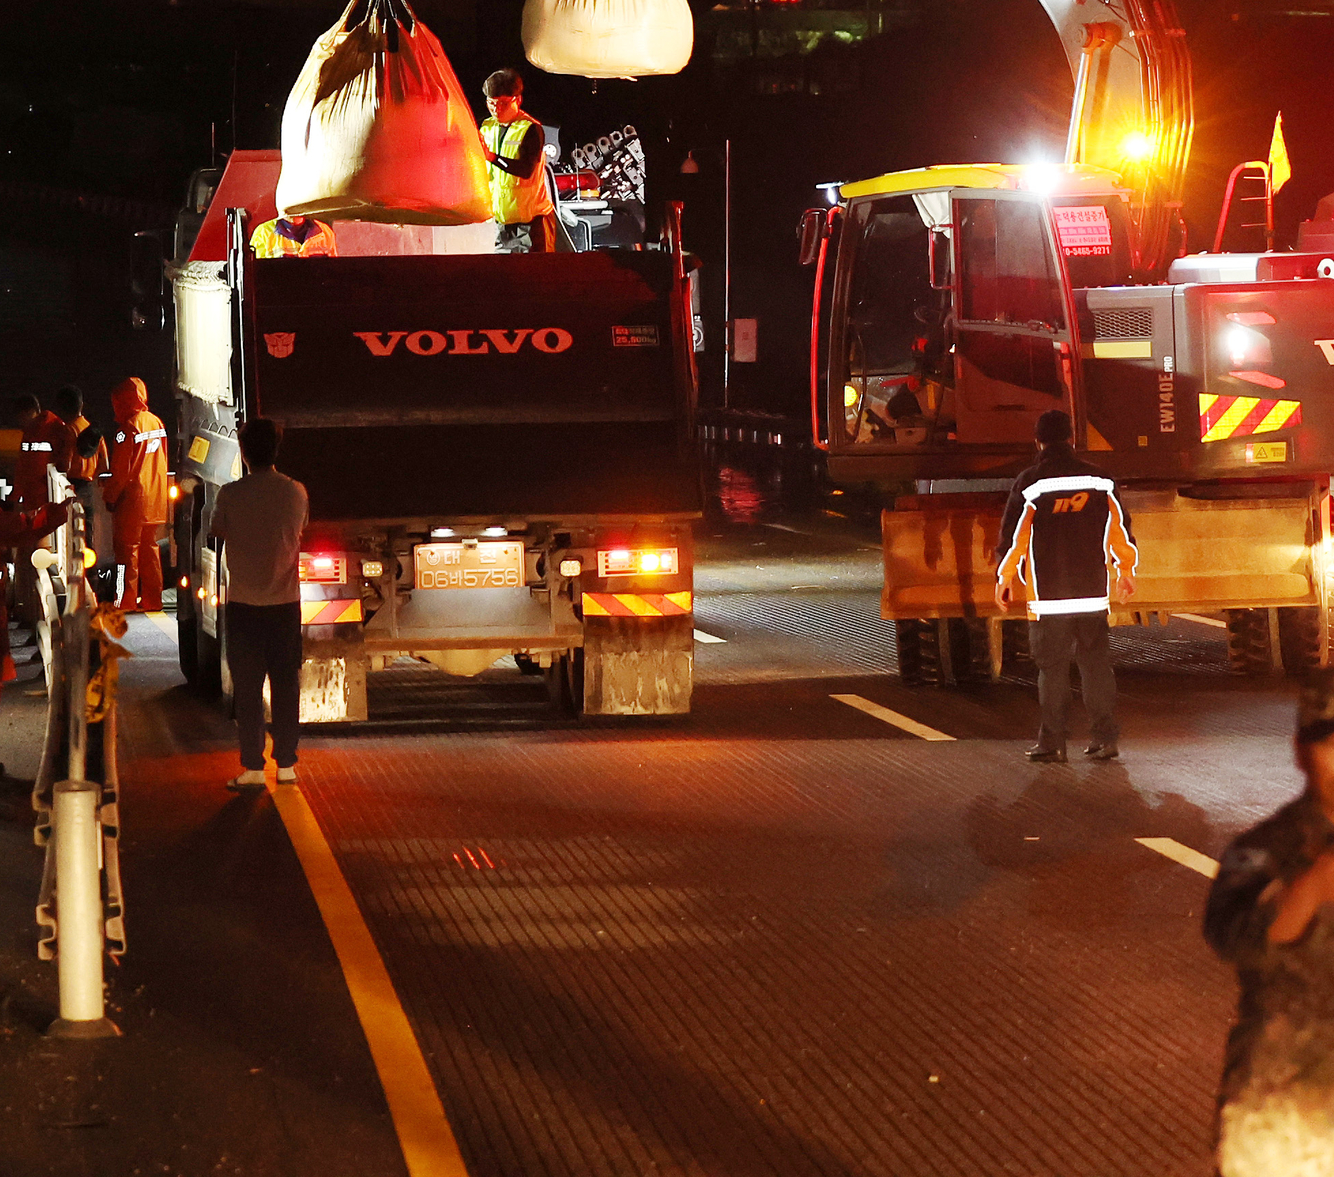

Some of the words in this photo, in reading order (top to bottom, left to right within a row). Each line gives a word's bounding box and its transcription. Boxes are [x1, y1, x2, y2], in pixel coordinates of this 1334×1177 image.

[353, 326, 573, 356] VOLVO
[1052, 491, 1090, 514] 119
[421, 568, 519, 588] 06바5756
